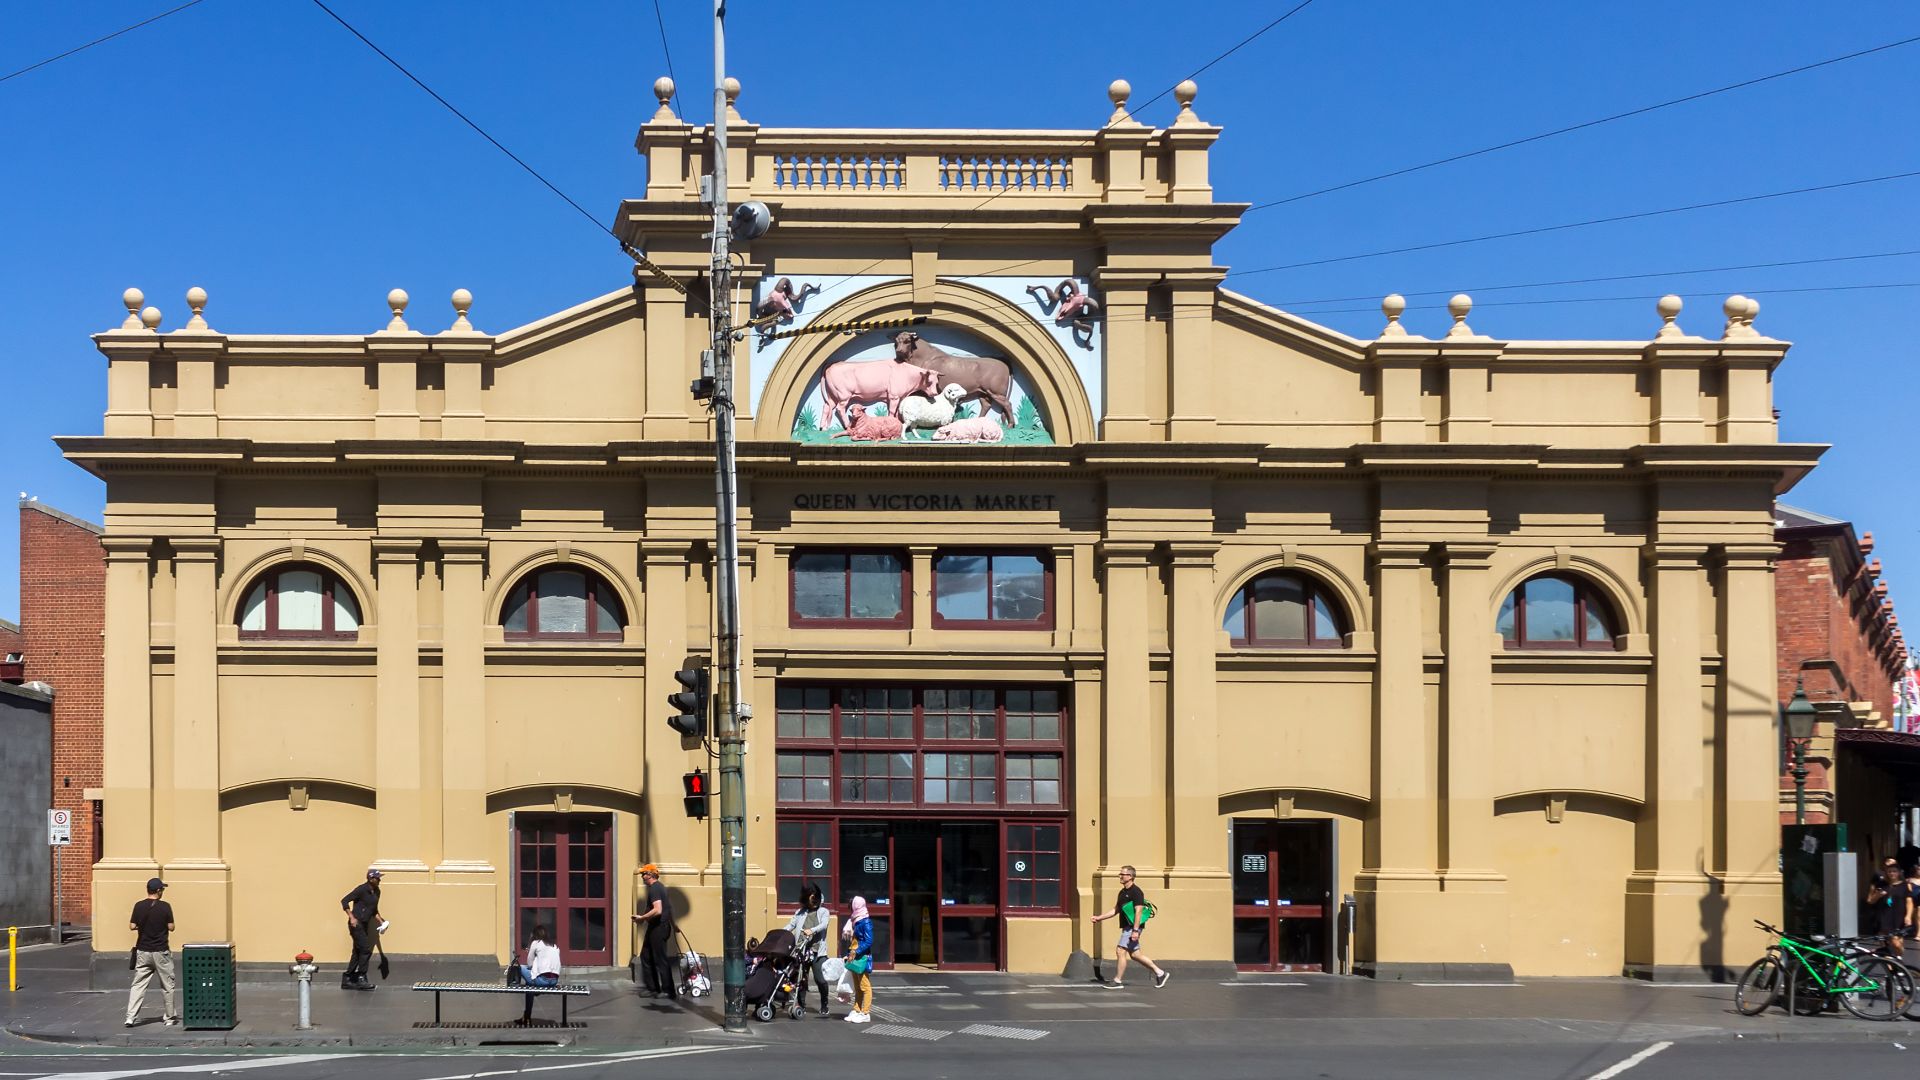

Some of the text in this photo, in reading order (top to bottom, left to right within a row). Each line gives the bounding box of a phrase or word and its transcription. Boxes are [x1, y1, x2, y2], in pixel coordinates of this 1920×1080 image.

[794, 494, 1055, 510] QUEEN VICTORIA MARKET
